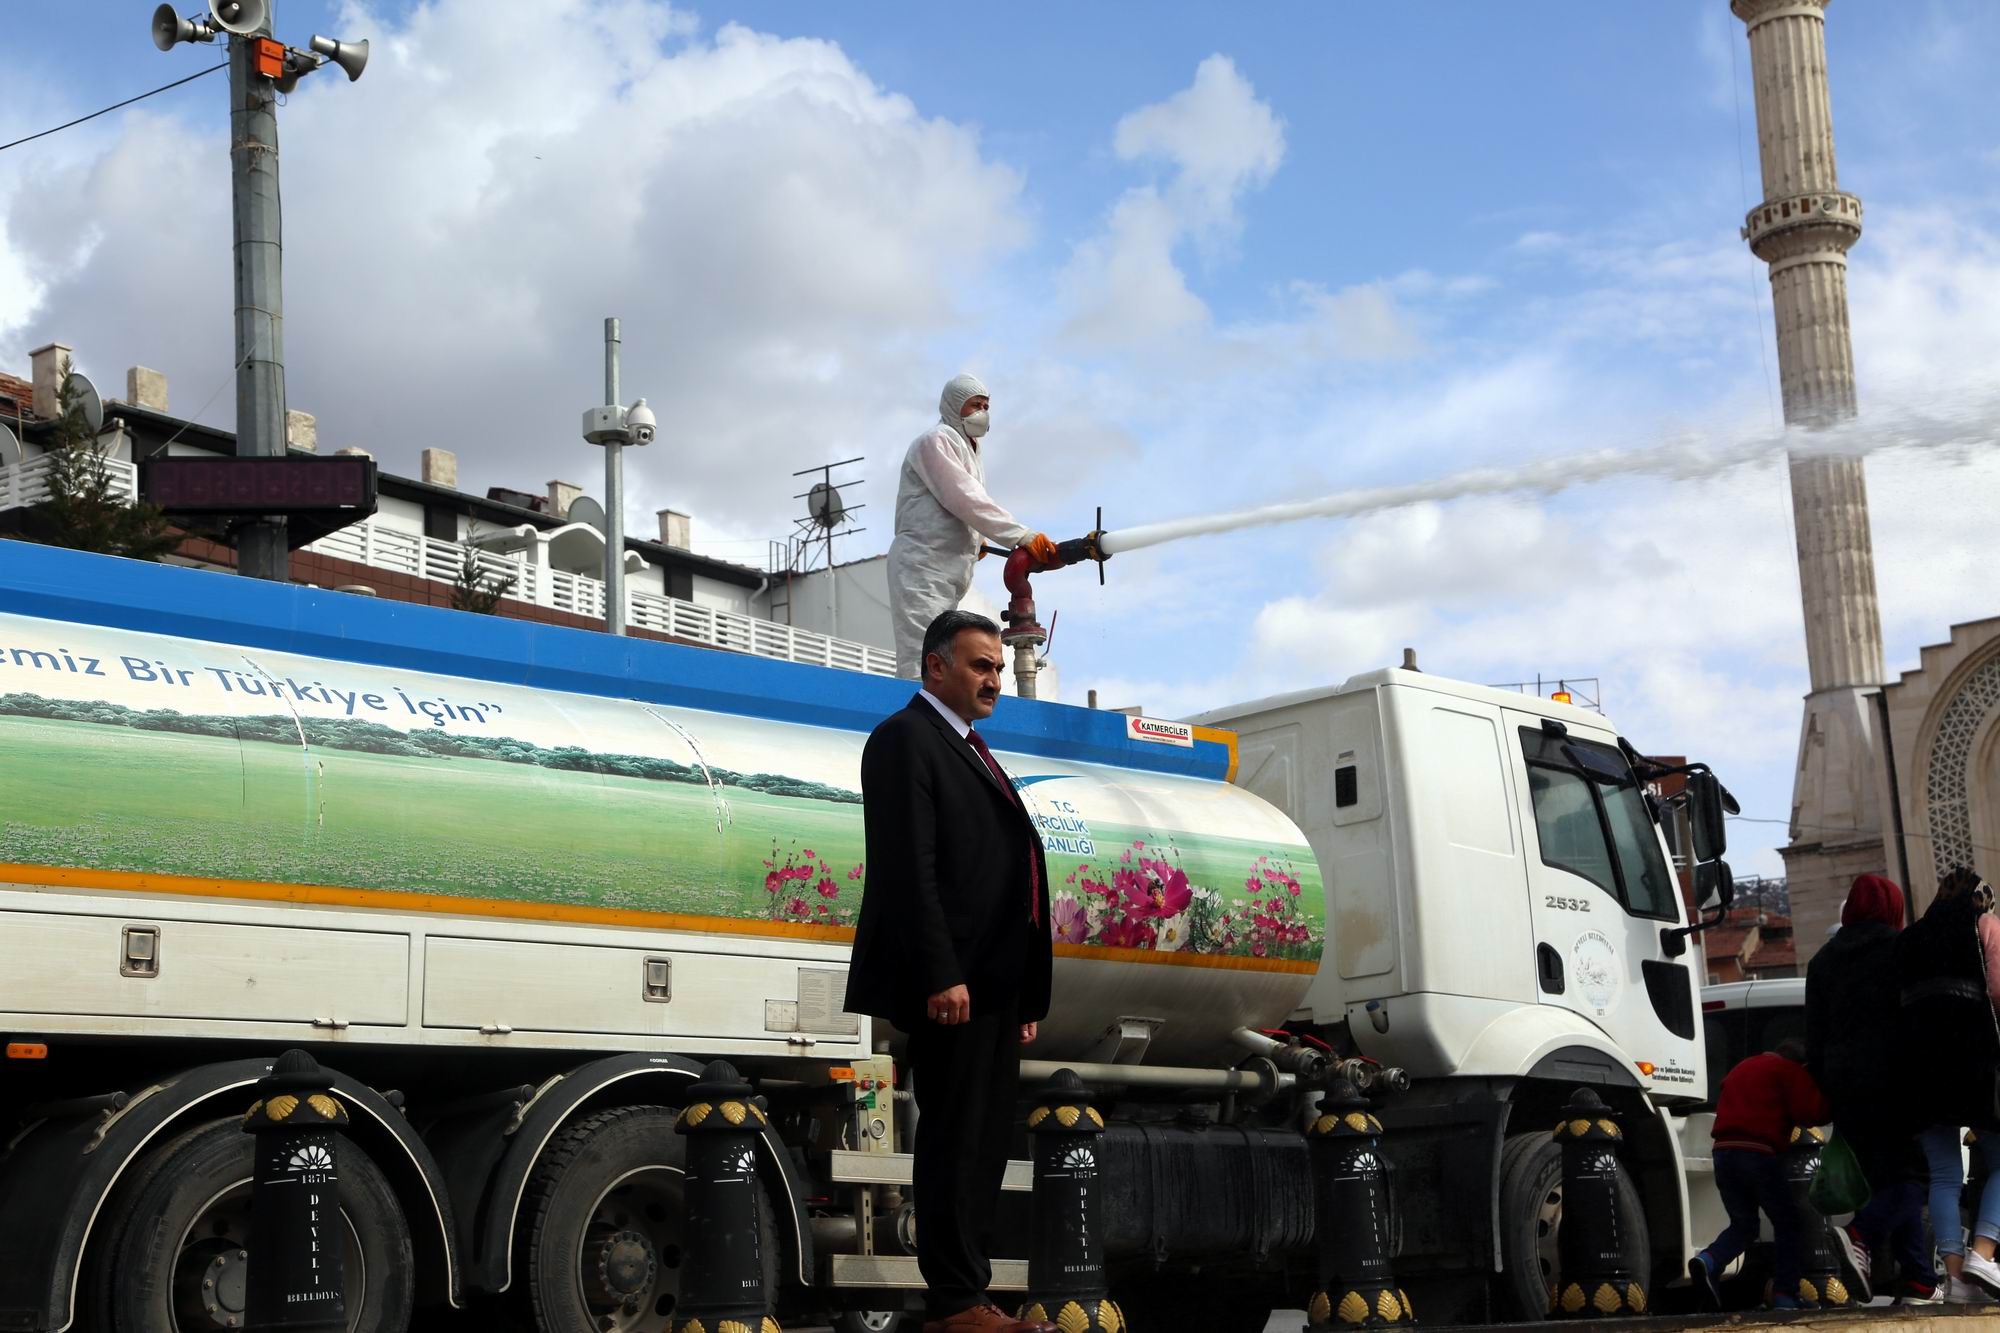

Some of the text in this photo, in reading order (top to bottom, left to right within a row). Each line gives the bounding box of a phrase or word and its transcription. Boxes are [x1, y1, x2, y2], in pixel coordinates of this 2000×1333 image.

[120, 655, 195, 687] Bir
[204, 667, 388, 715] Türkiye
[1141, 722, 1189, 736] KATMERCİLER
[1050, 800, 1080, 814] T.C.
[1545, 896, 1591, 912] 2532
[301, 1174, 327, 1184] 1871
